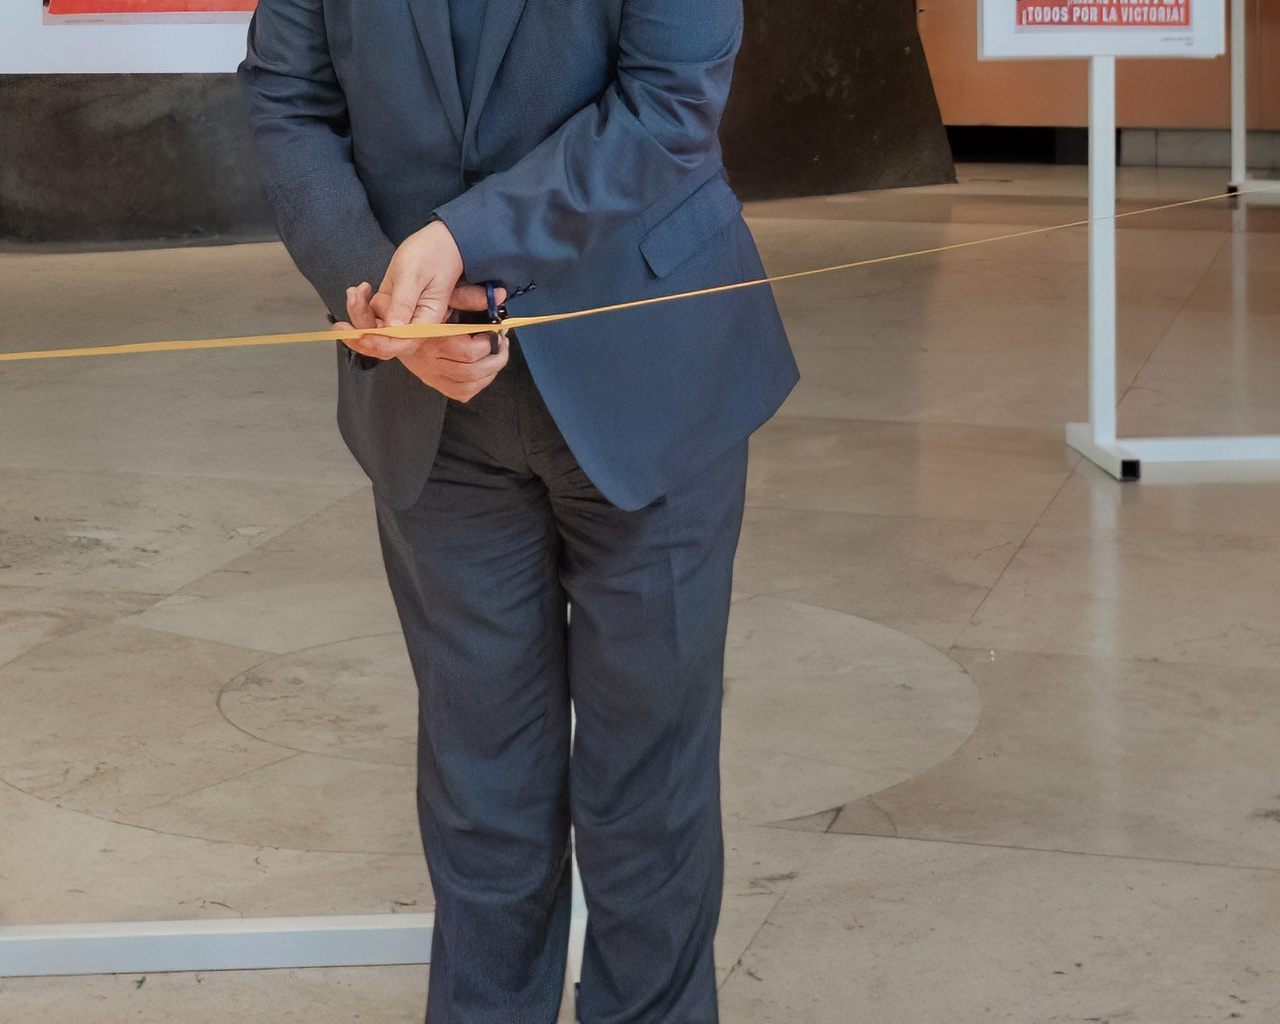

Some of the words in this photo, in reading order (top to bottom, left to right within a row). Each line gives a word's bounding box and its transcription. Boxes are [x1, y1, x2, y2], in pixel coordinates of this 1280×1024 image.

[1022, 6, 1069, 25] ¡TODOS
[1073, 7, 1098, 22] POR
[1102, 7, 1118, 22] LA
[1121, 6, 1186, 23] VICTORIA!
